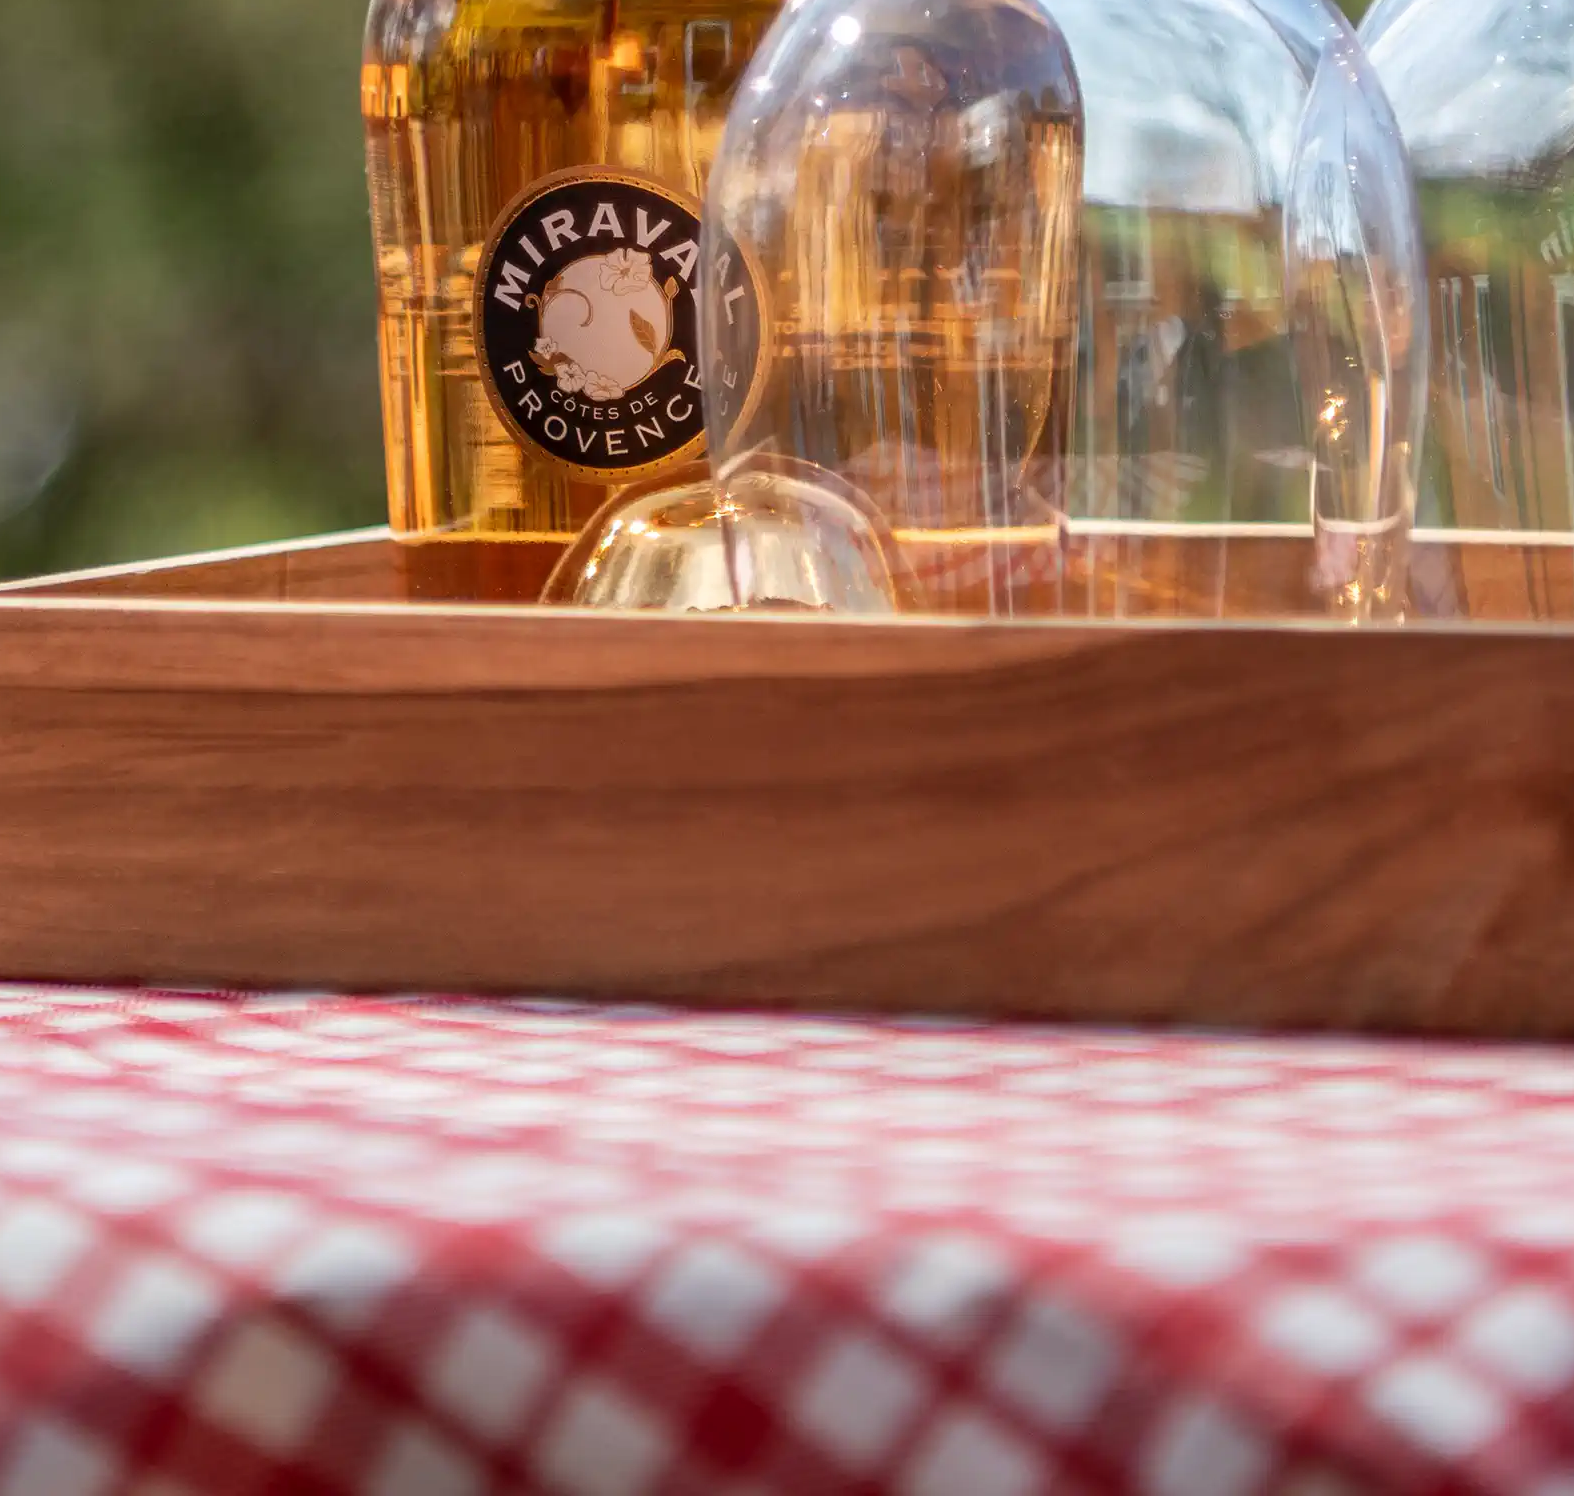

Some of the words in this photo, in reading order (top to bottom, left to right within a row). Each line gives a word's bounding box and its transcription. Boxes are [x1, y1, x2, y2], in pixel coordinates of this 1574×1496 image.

[503, 359, 703, 456] PROVENCE
[550, 388, 620, 421] CÔTES
[630, 391, 659, 415] DE
